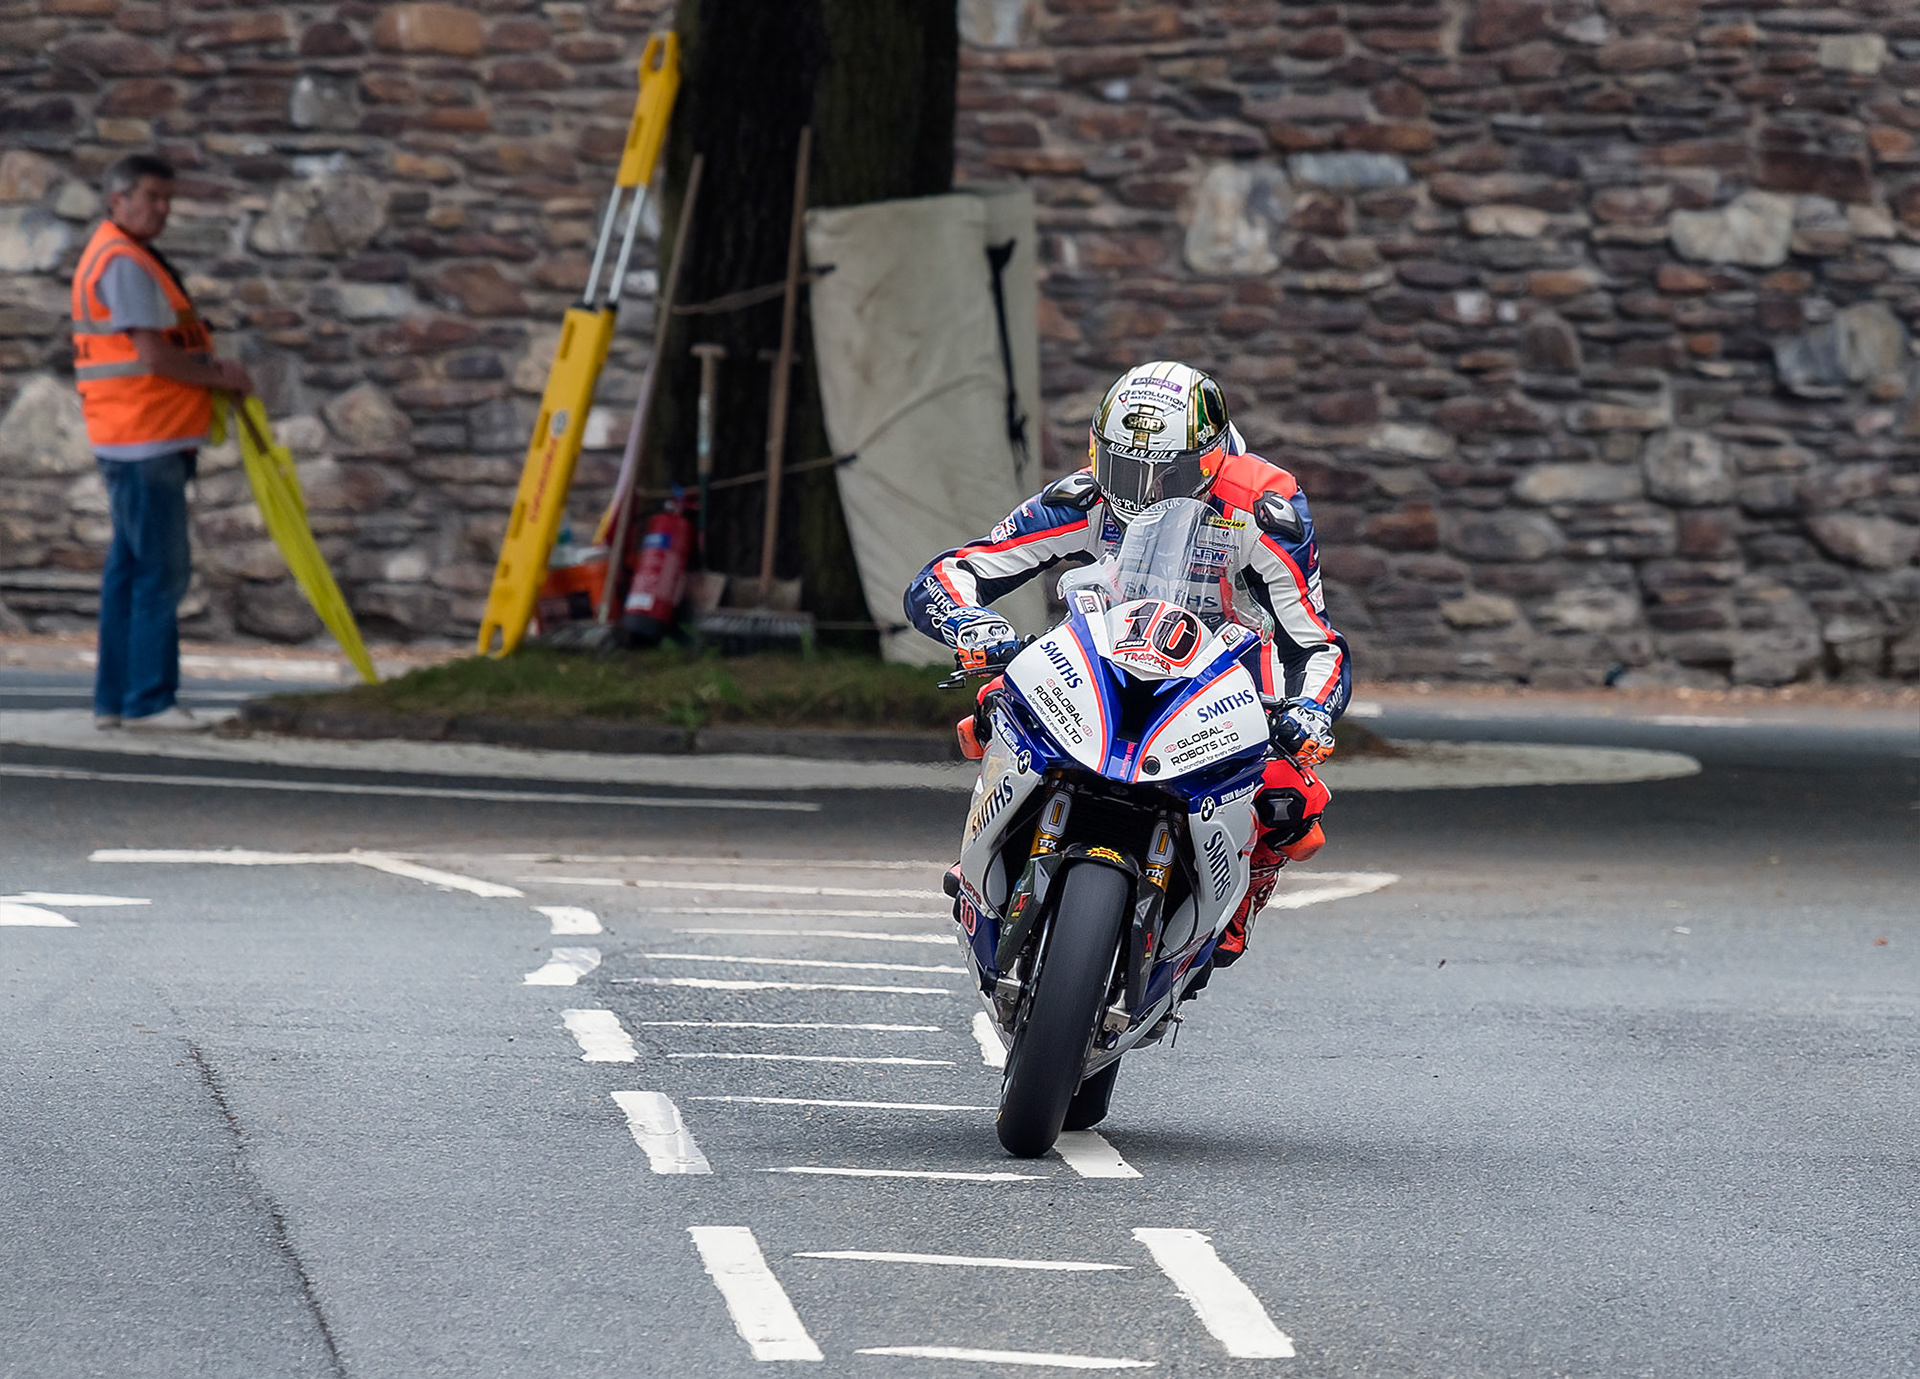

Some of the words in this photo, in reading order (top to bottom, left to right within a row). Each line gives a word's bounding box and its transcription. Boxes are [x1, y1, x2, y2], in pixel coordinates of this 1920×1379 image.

[1131, 390, 1187, 409] EVOLUTION
[1134, 378, 1179, 392] BATHGATE
[1127, 415, 1162, 431] SHOEI
[1109, 442, 1148, 457] NOLAN
[1148, 451, 1180, 460] OILS
[923, 576, 956, 614] SMITHS
[1113, 599, 1202, 667] 10
[1040, 641, 1084, 689] SMITHS
[1034, 685, 1068, 725] ROBOTS
[1064, 723, 1083, 744] LTD
[1052, 686, 1082, 727] GLOBAL
[1196, 689, 1254, 722] SMITHS
[1170, 740, 1219, 766] ROBOTS
[1218, 732, 1239, 746] LTD
[1177, 726, 1223, 749] GLOBAL
[972, 776, 1013, 842] SMITHS
[1037, 838, 1058, 851] TTX
[1145, 867, 1166, 880] TTX
[1203, 830, 1231, 902] SMITHS
[960, 895, 977, 934] 10
